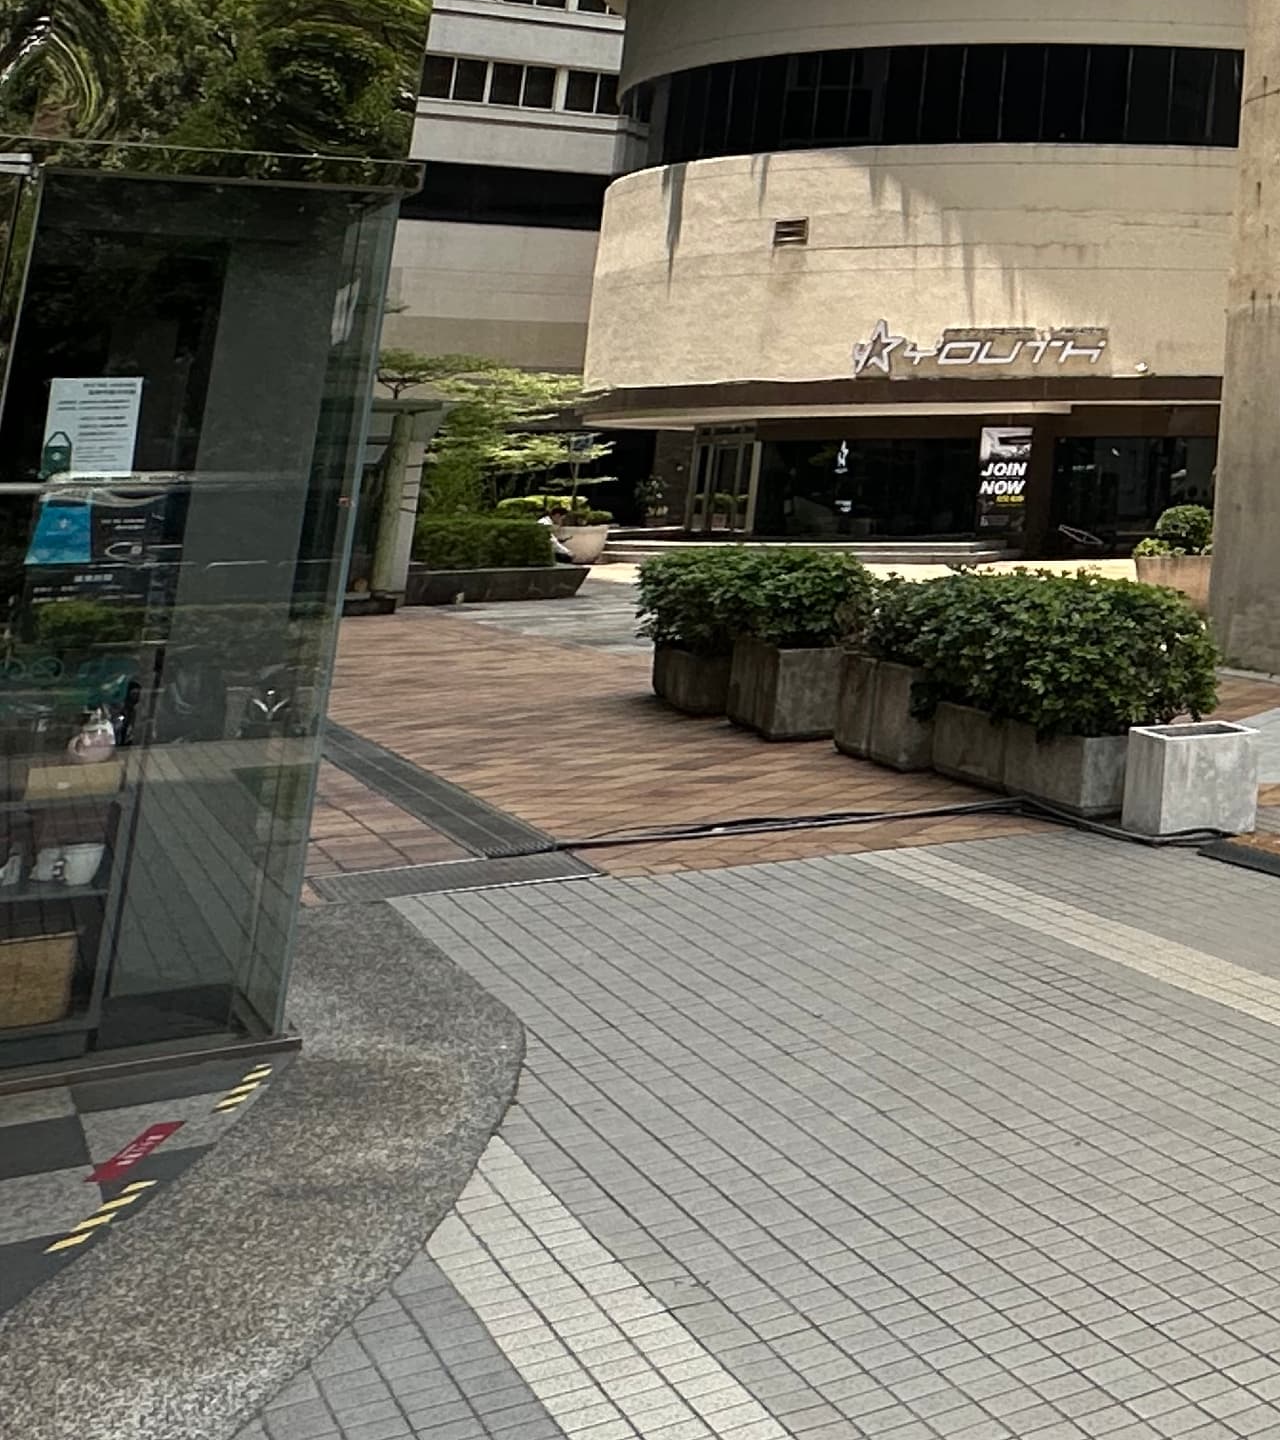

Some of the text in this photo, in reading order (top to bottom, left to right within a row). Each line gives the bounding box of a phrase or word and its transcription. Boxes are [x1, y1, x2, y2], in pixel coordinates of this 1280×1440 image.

[903, 339, 1107, 365] YOUTH
[980, 461, 1028, 477] JOIN
[979, 479, 1026, 495] NOW
